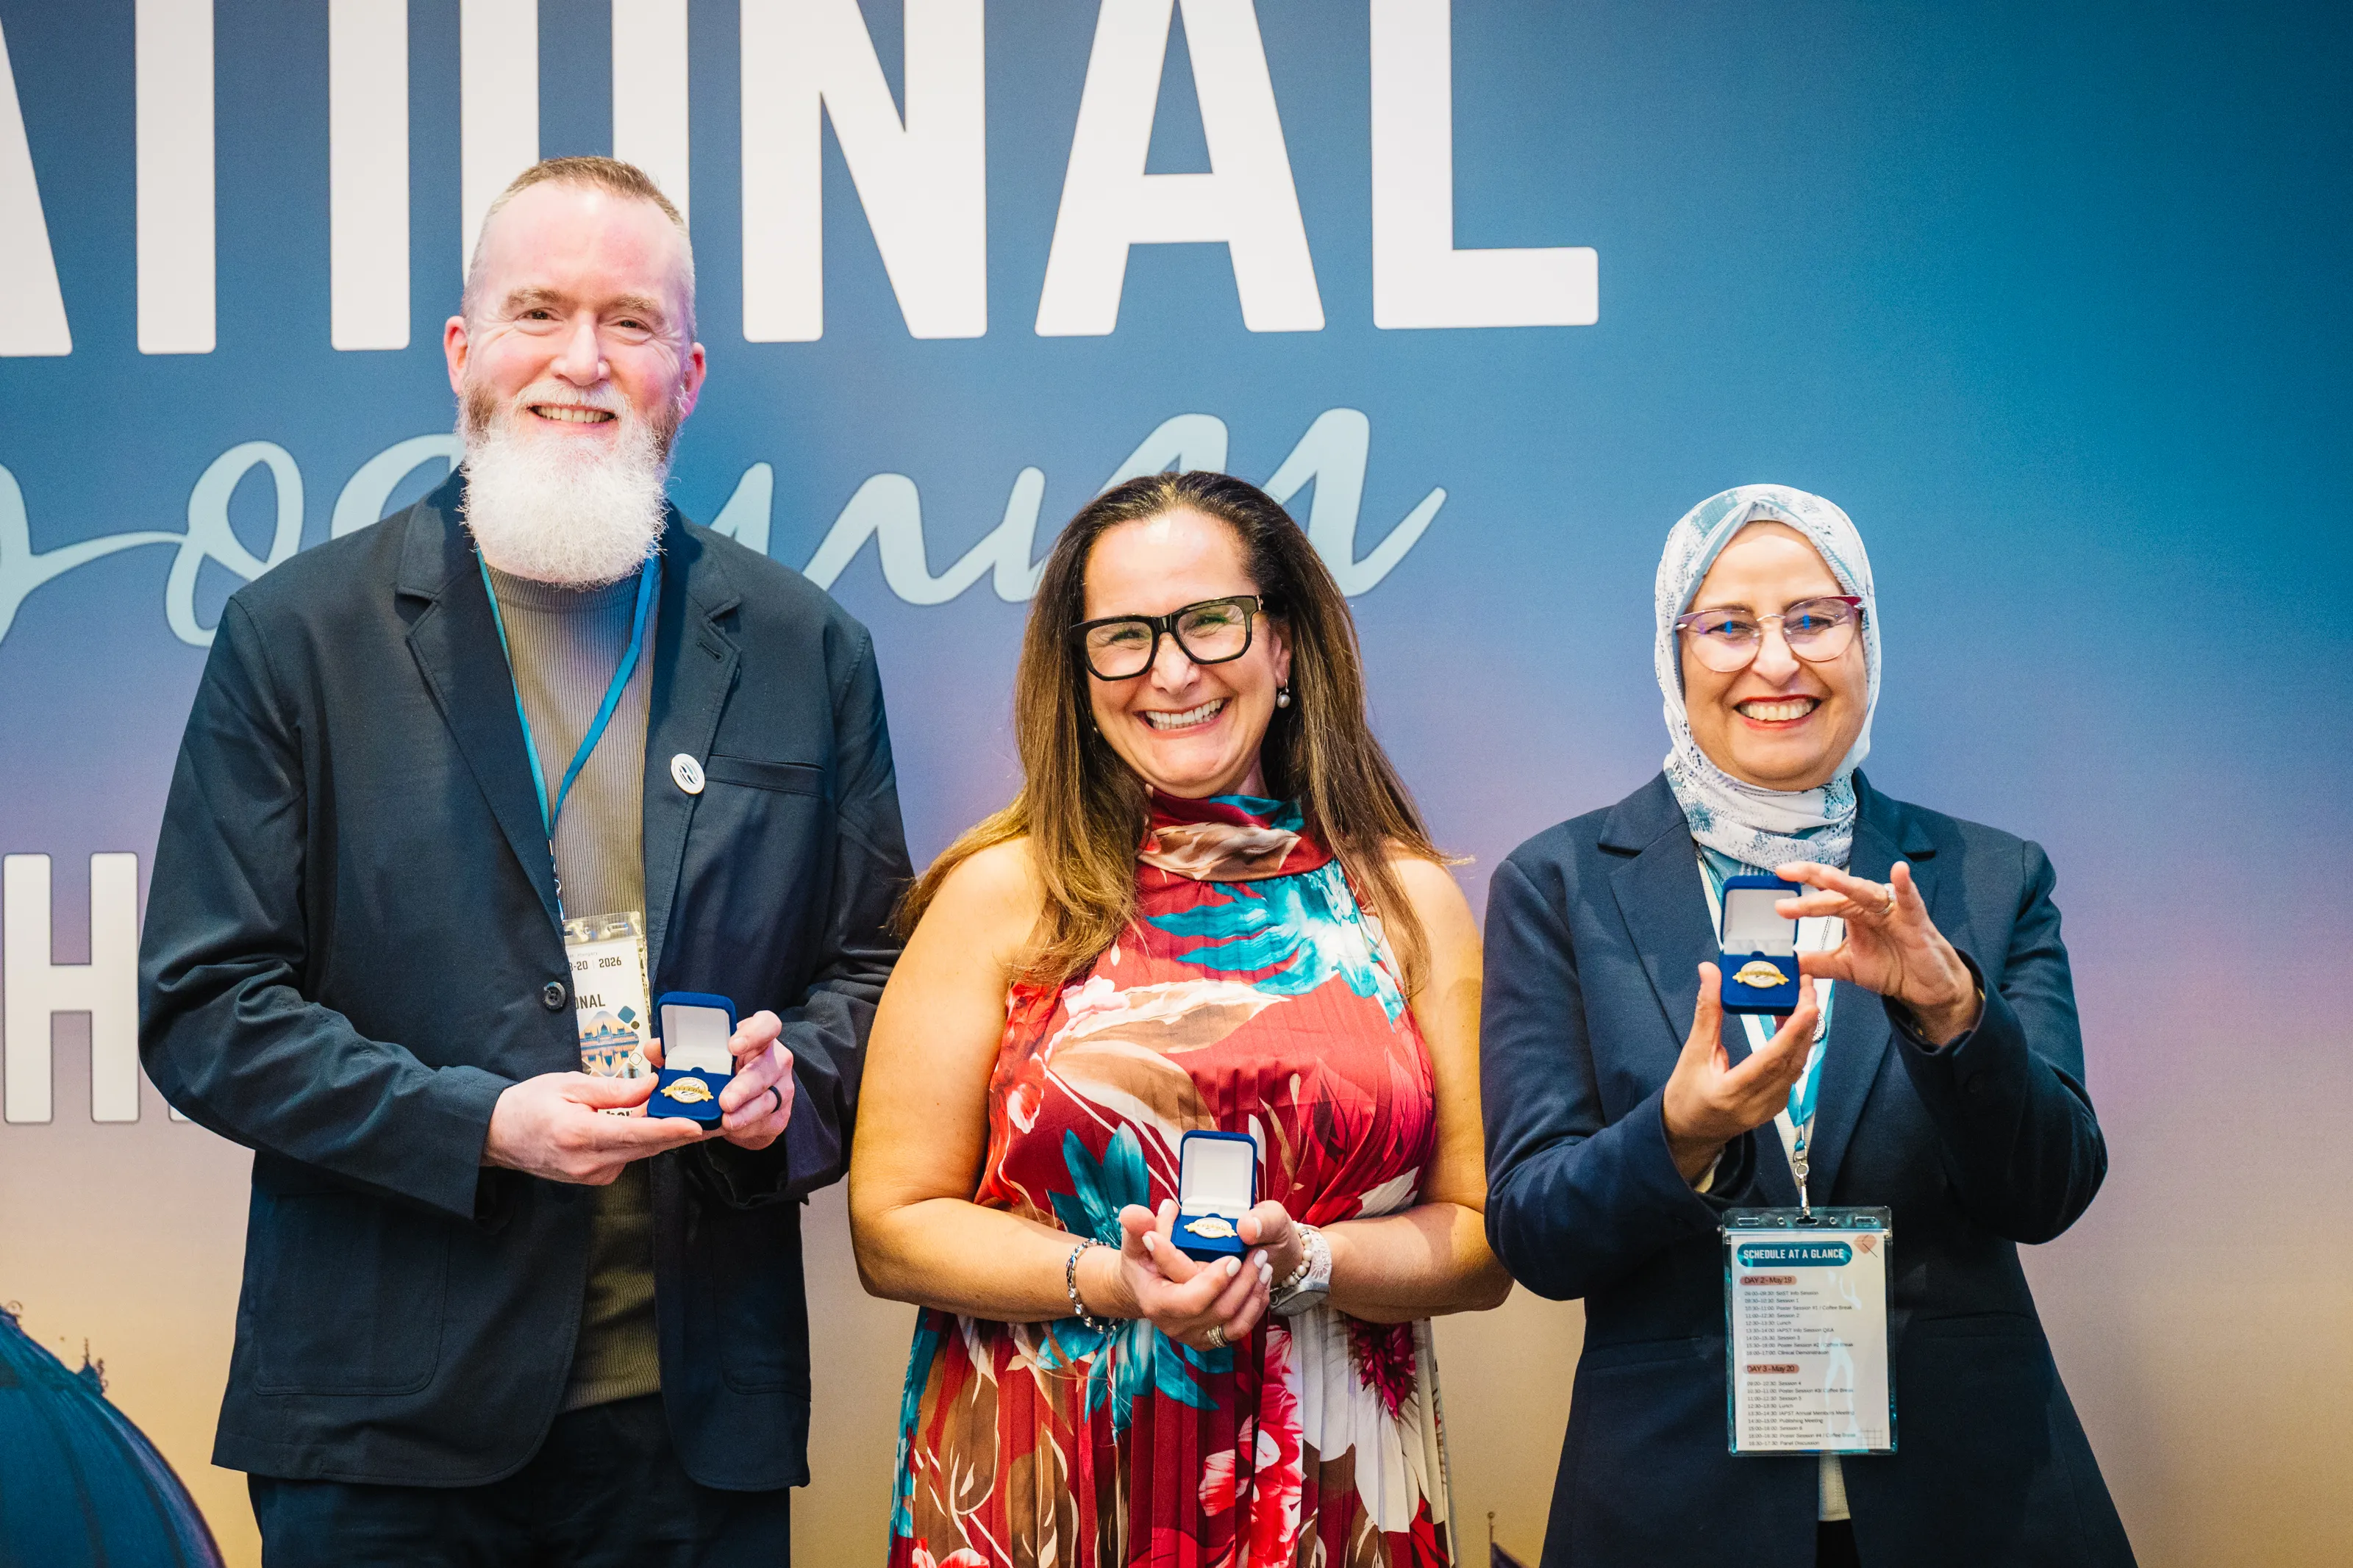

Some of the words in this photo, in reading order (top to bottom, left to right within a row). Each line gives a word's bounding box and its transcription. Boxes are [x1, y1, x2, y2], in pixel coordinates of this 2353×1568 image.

[599, 956, 622, 968] 2026
[4, 853, 191, 1123] H
[1743, 1250, 1785, 1259] SCHEDULE
[1788, 1249, 1799, 1259] AT
[1802, 1249, 1809, 1259] A
[1810, 1249, 1844, 1259] GLANCE
[1772, 1365, 1785, 1373] May
